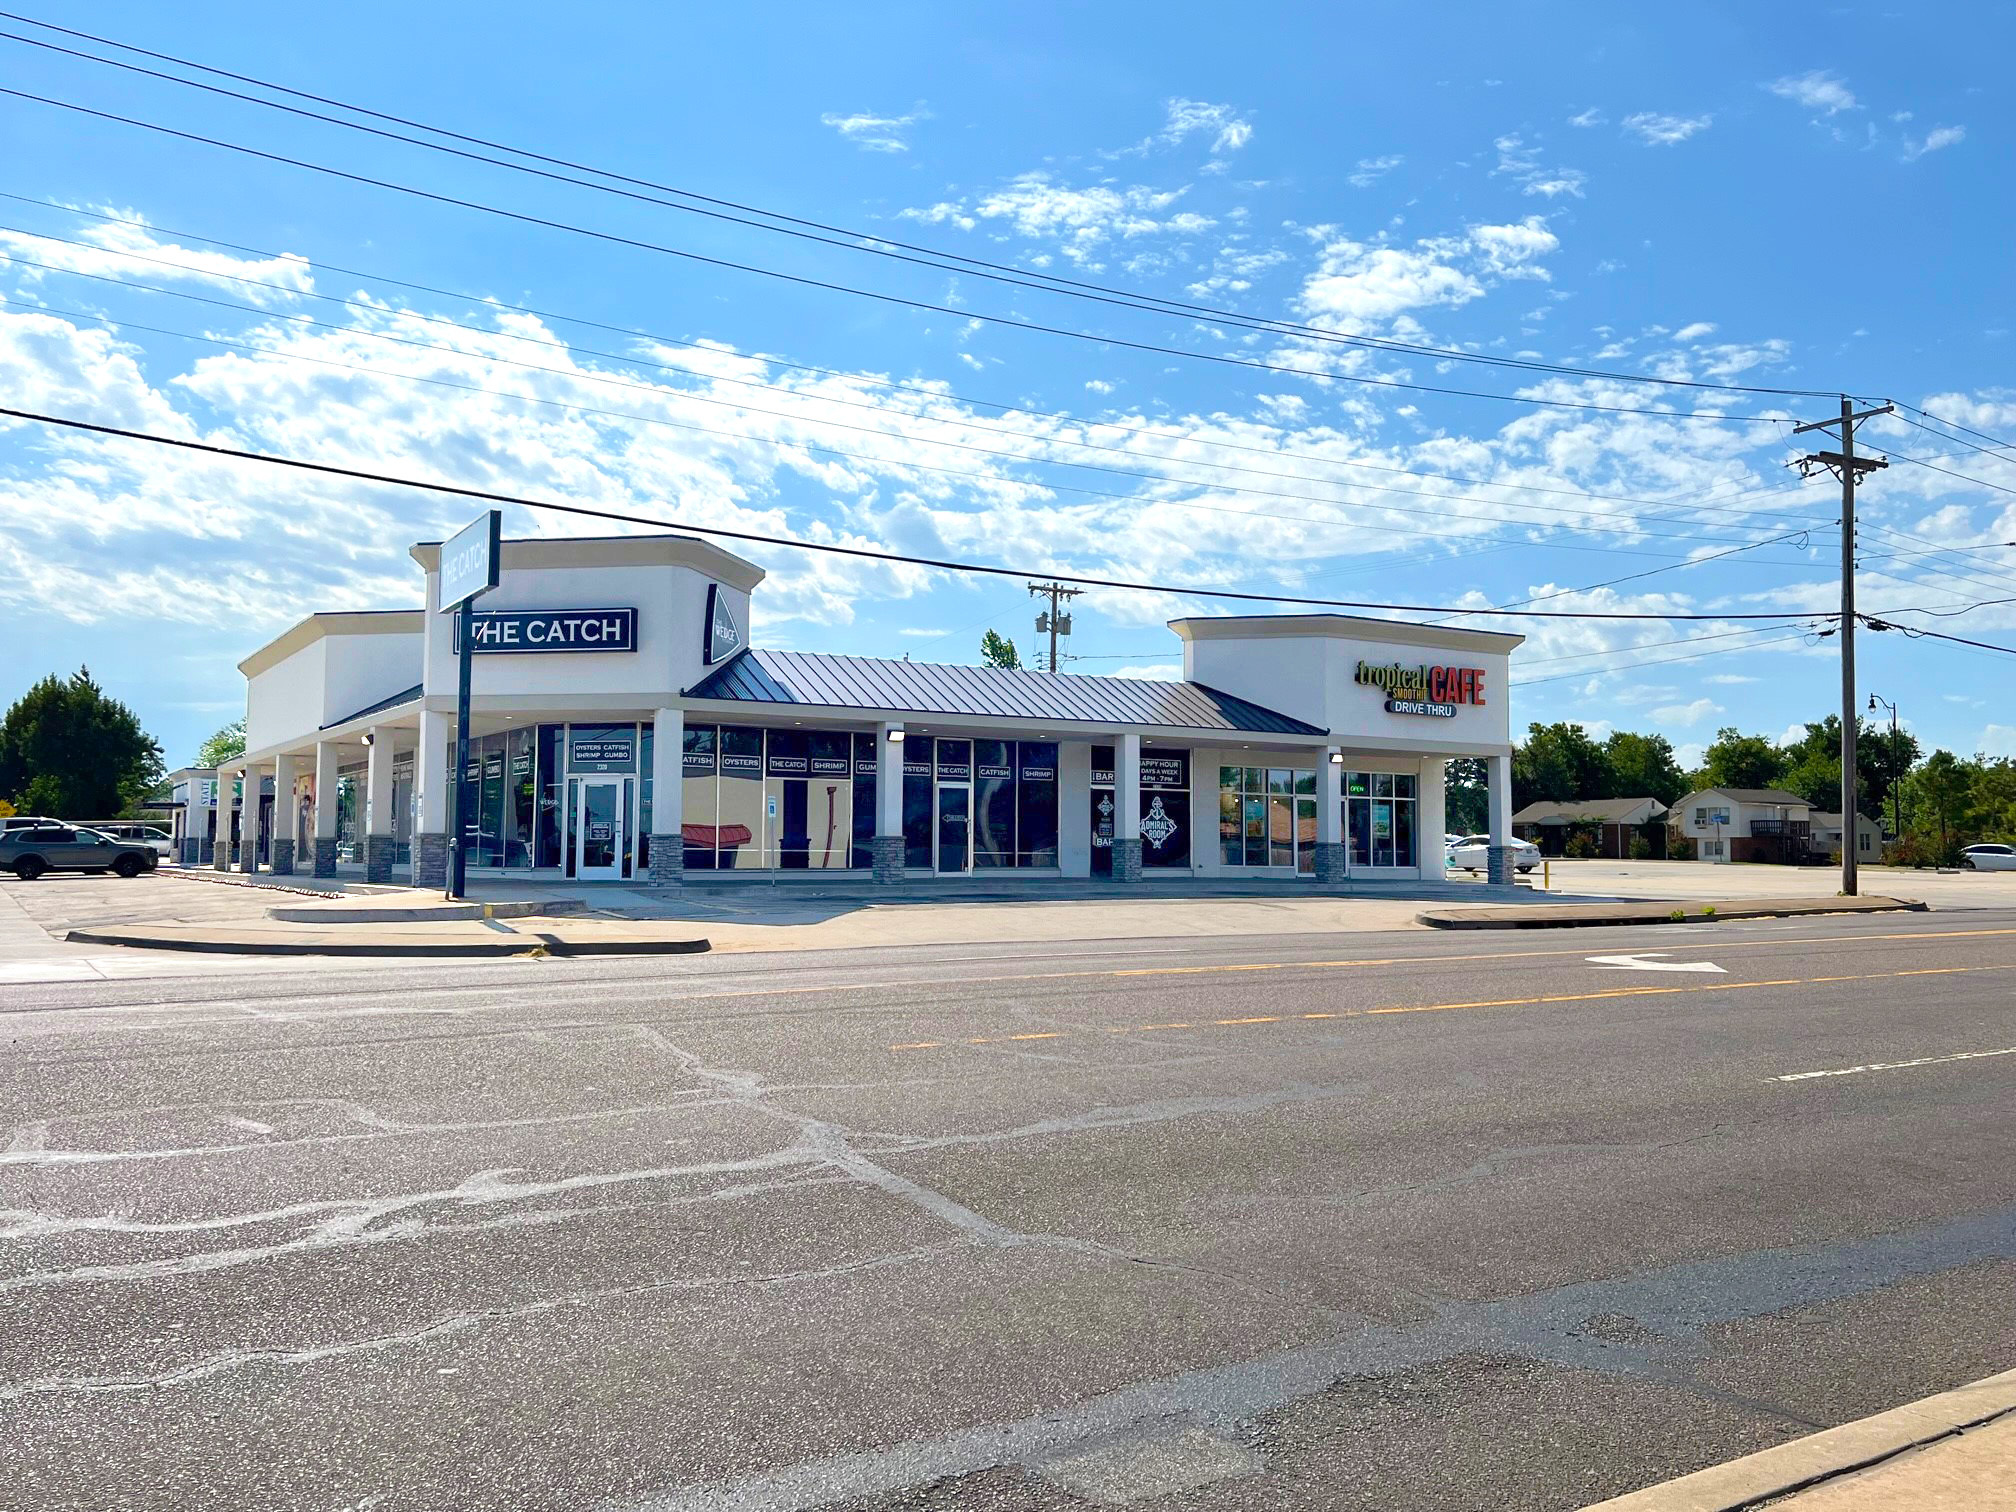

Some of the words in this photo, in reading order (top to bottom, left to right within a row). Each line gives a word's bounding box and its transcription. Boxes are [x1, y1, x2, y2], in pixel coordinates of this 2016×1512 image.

[443, 557, 458, 588] THE
[459, 537, 487, 577] CATCH
[526, 618, 622, 643] CATCH
[1358, 660, 1428, 692] tropical
[1431, 666, 1486, 705] CAFE
[1395, 702, 1424, 714] DRIVE
[1426, 704, 1452, 716] THRU
[683, 756, 712, 764] ATFISH
[724, 758, 759, 767] OYSTERS
[771, 760, 784, 768] THE
[814, 762, 845, 770] SHRIMP
[903, 765, 929, 773] YSTERS
[980, 768, 1010, 776] CATFISH
[1095, 772, 1114, 781] BAR
[201, 781, 210, 806] STATE
[1350, 785, 1365, 793] OPEN
[1141, 820, 1175, 835] ADMIRAL'S
[1148, 830, 1166, 839] ROOM
